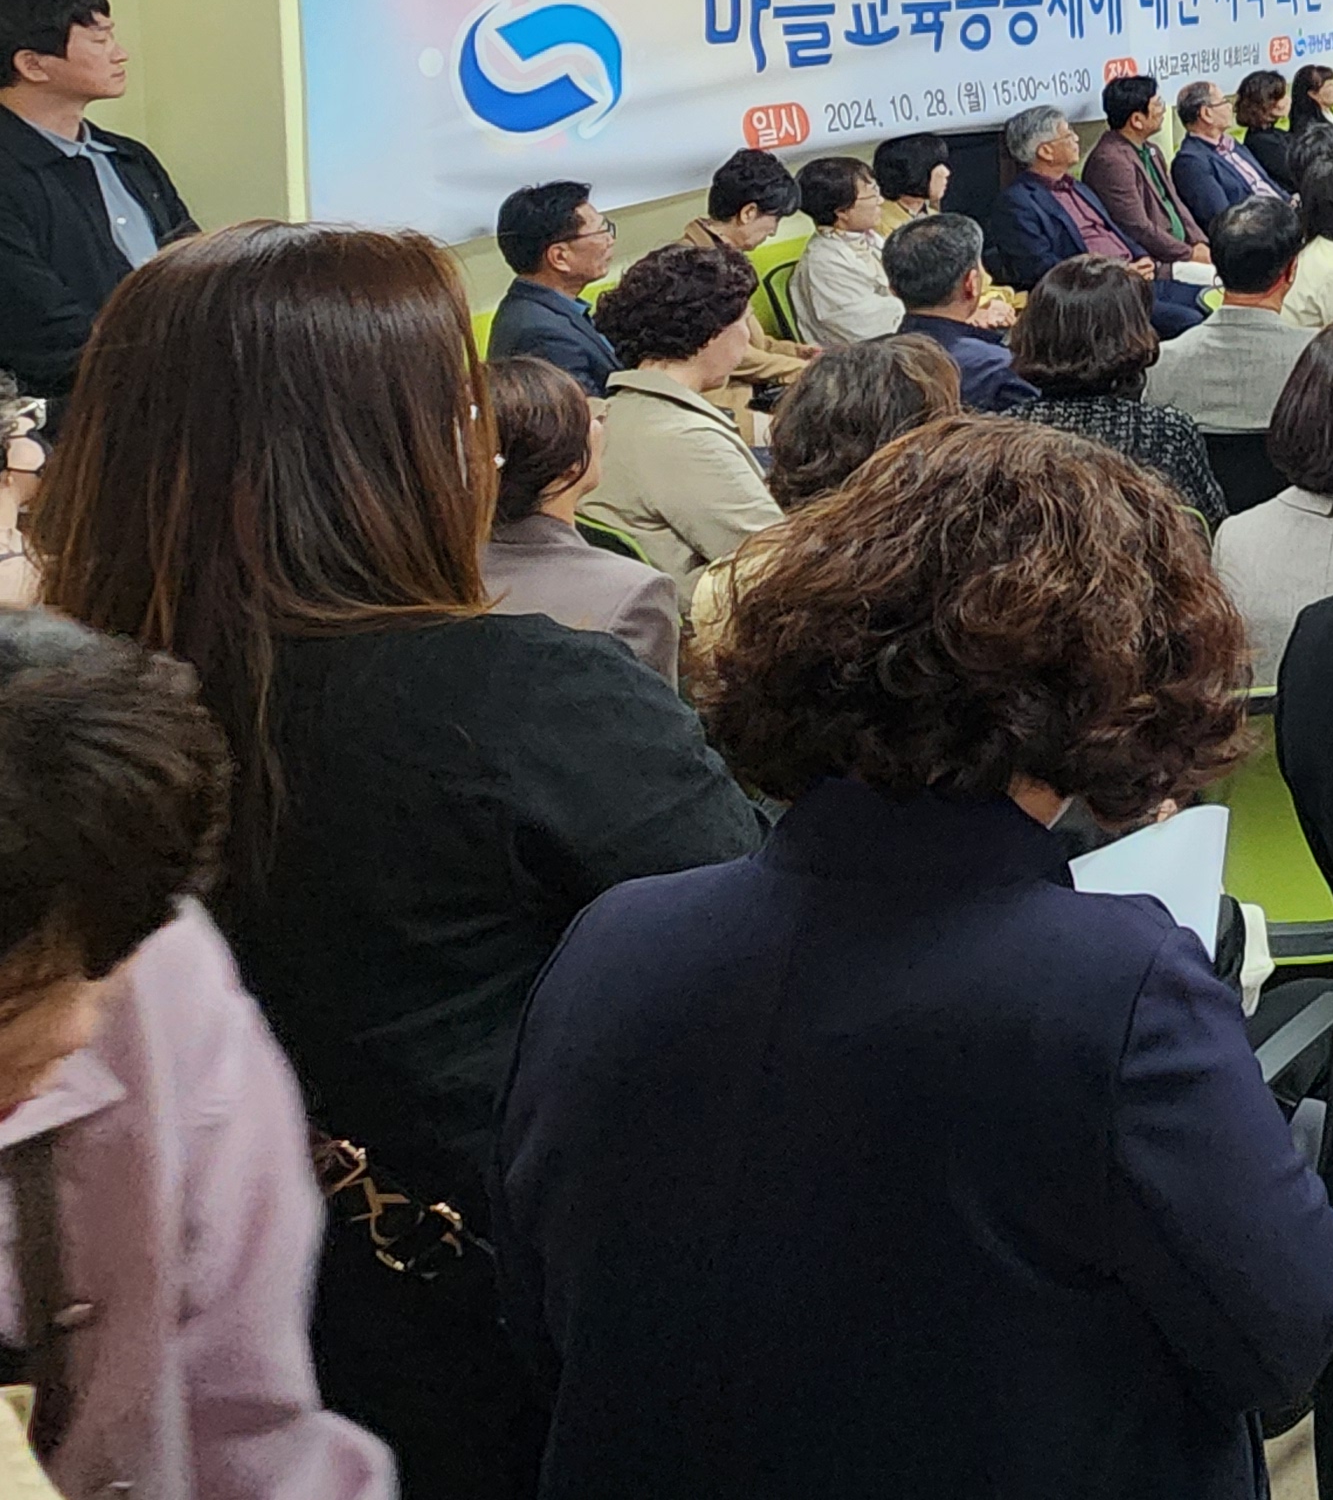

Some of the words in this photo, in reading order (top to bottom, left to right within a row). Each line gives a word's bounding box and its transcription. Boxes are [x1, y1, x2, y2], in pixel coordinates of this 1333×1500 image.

[1146, 53, 1221, 80] 사천교육지원청
[1224, 42, 1261, 68] 대회의실
[1271, 39, 1291, 62] 주관
[751, 104, 802, 144] 일시
[824, 99, 884, 133] 2024.
[889, 95, 919, 124] 10.
[923, 88, 953, 117] 28.
[957, 80, 986, 116] (월)
[992, 67, 1091, 107] 15:00~16:30
